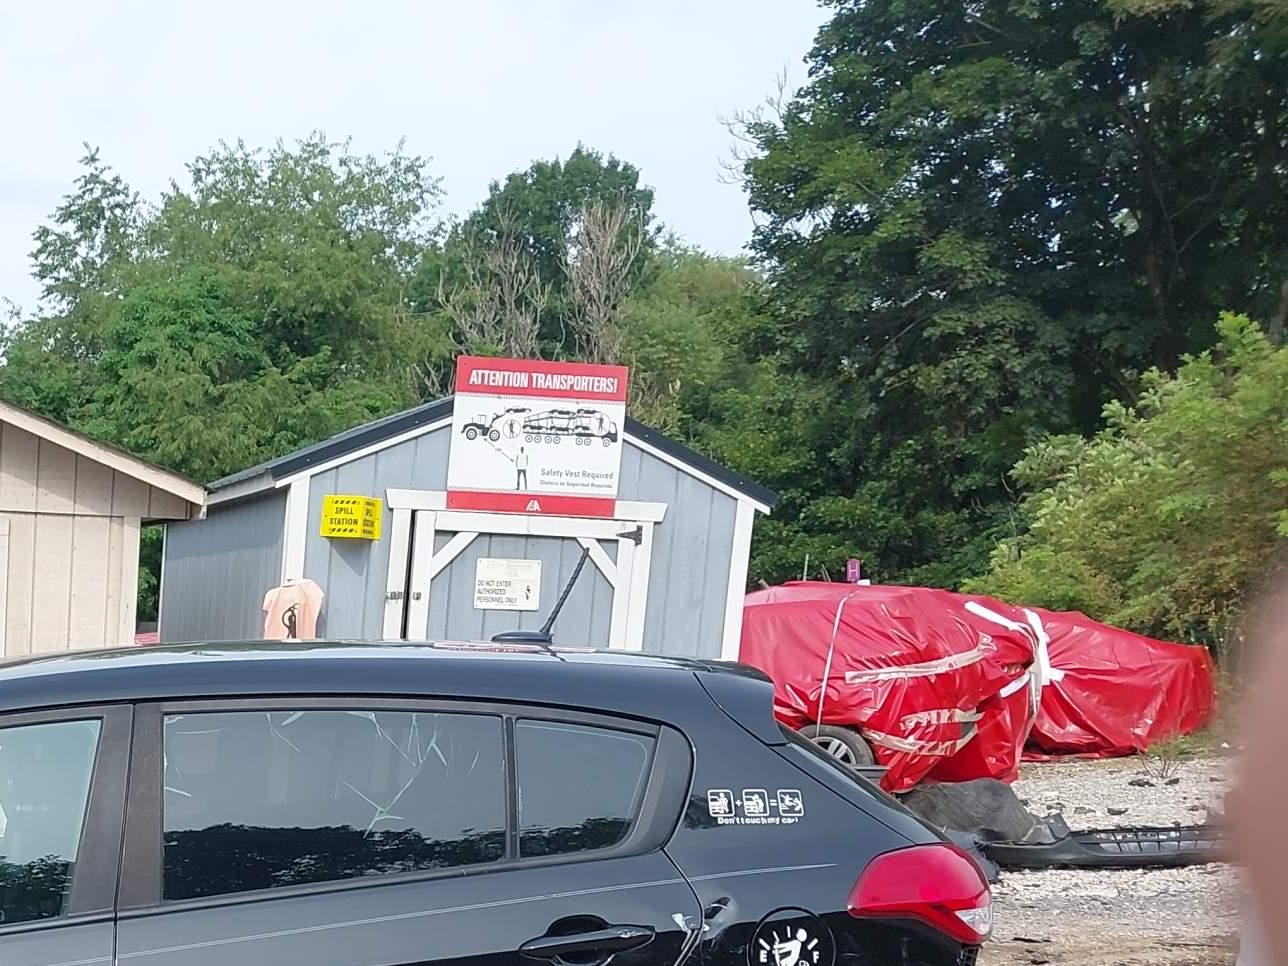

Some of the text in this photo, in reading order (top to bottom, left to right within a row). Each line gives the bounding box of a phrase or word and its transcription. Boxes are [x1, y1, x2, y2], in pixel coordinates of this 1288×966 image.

[469, 370, 618, 393] ATTENTION TRANSPORTERS!
[541, 468, 614, 480] Safety Vest Required
[335, 507, 354, 515] SPILL
[329, 518, 358, 526] STATION
[740, 816, 767, 825] touch
[767, 816, 780, 825] my
[759, 949, 820, 964] E F
